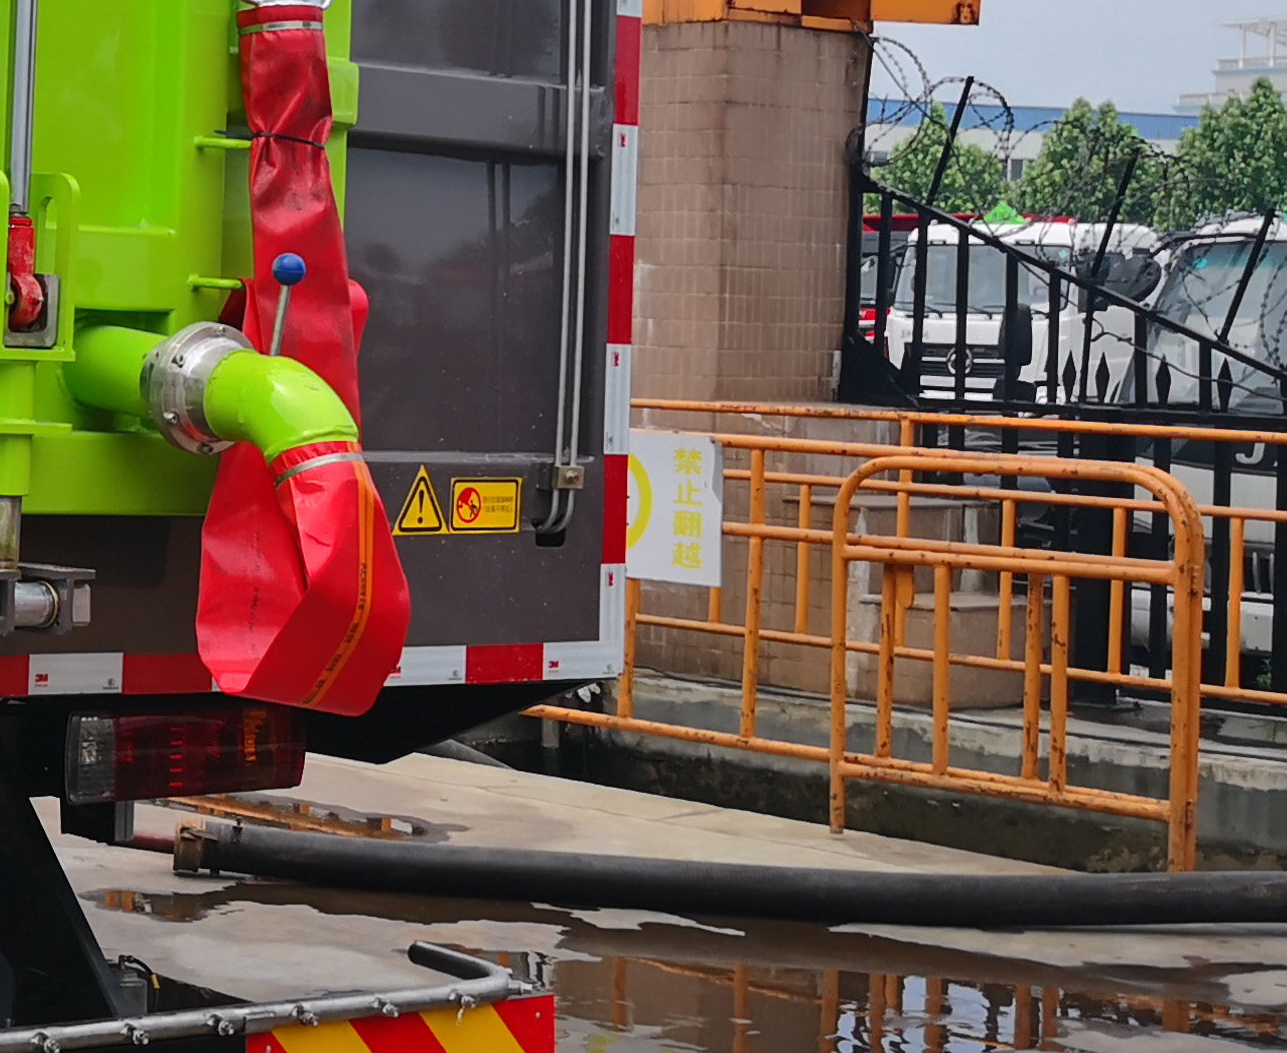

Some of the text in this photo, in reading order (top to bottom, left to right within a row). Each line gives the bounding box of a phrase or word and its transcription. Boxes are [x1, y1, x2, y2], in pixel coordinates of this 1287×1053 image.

[672, 447, 703, 570] 禁止翻越
[35, 673, 48, 684] 3M
